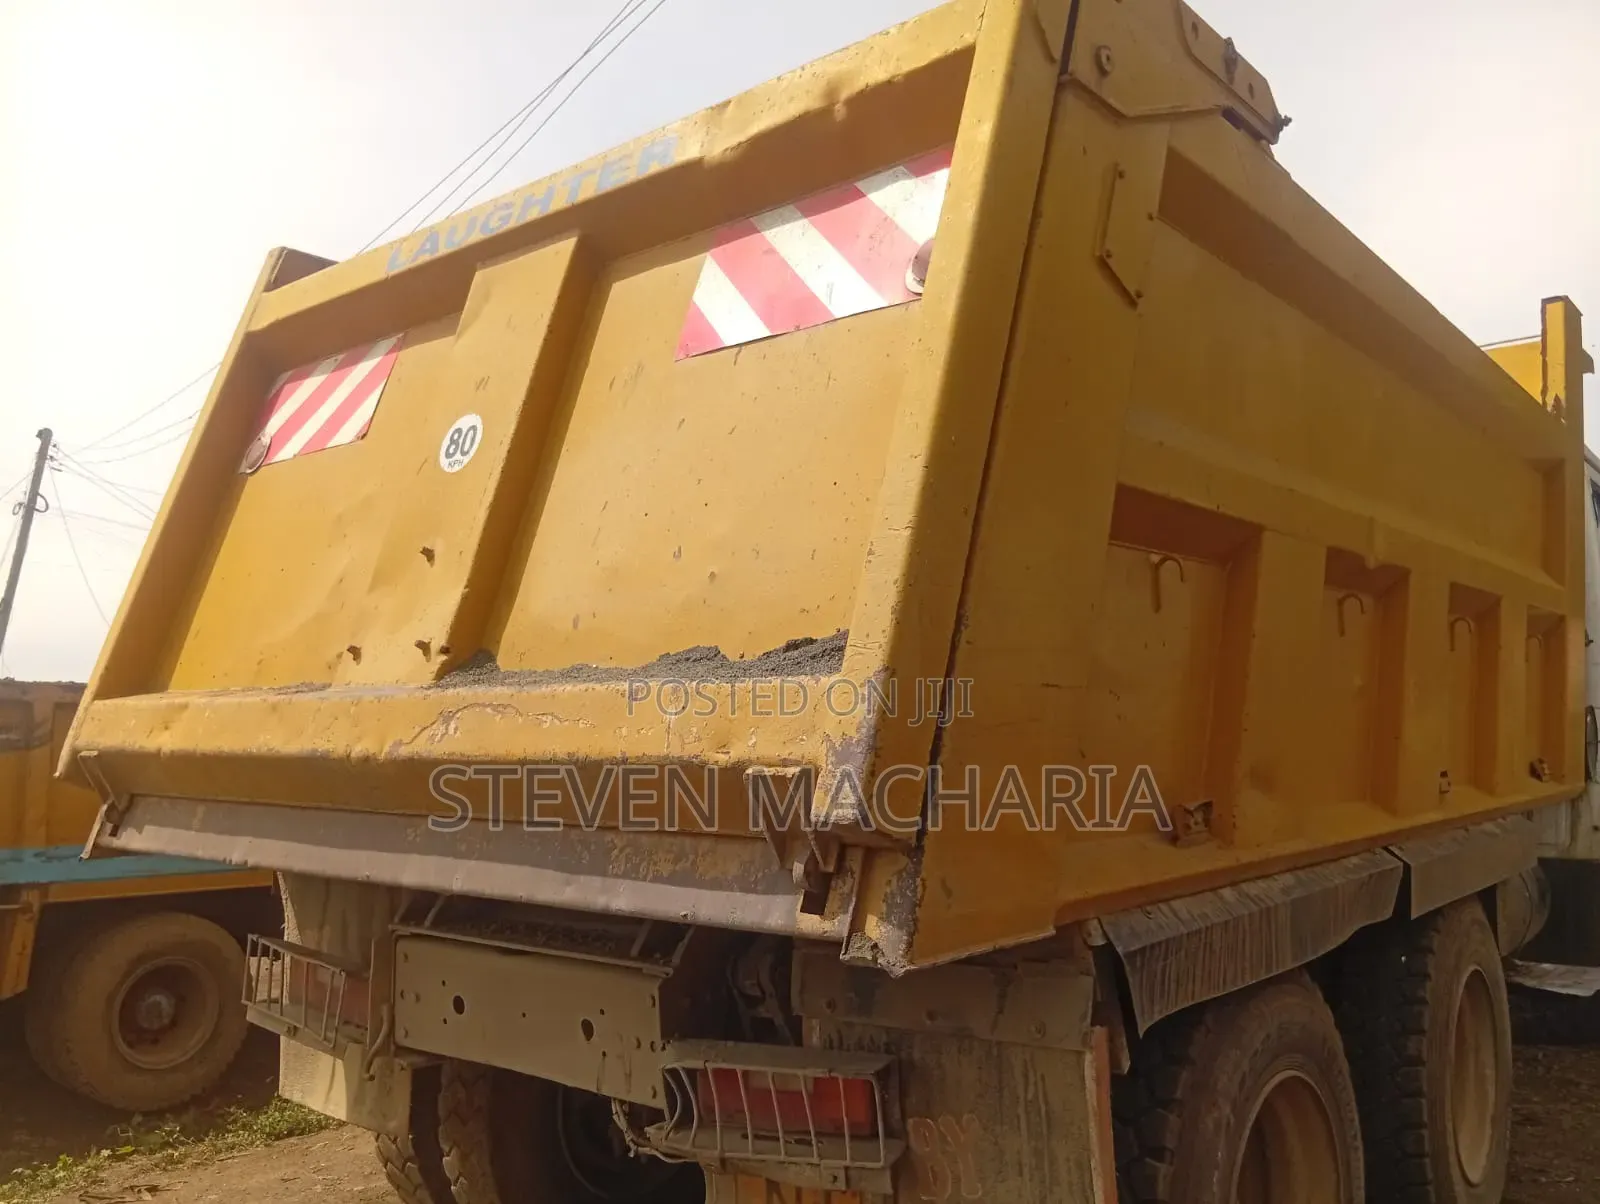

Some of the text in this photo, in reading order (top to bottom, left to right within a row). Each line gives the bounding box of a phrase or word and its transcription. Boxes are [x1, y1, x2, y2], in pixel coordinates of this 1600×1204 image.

[386, 135, 678, 273] LAUGHTER
[444, 424, 478, 460] 80
[447, 459, 464, 469] KPH
